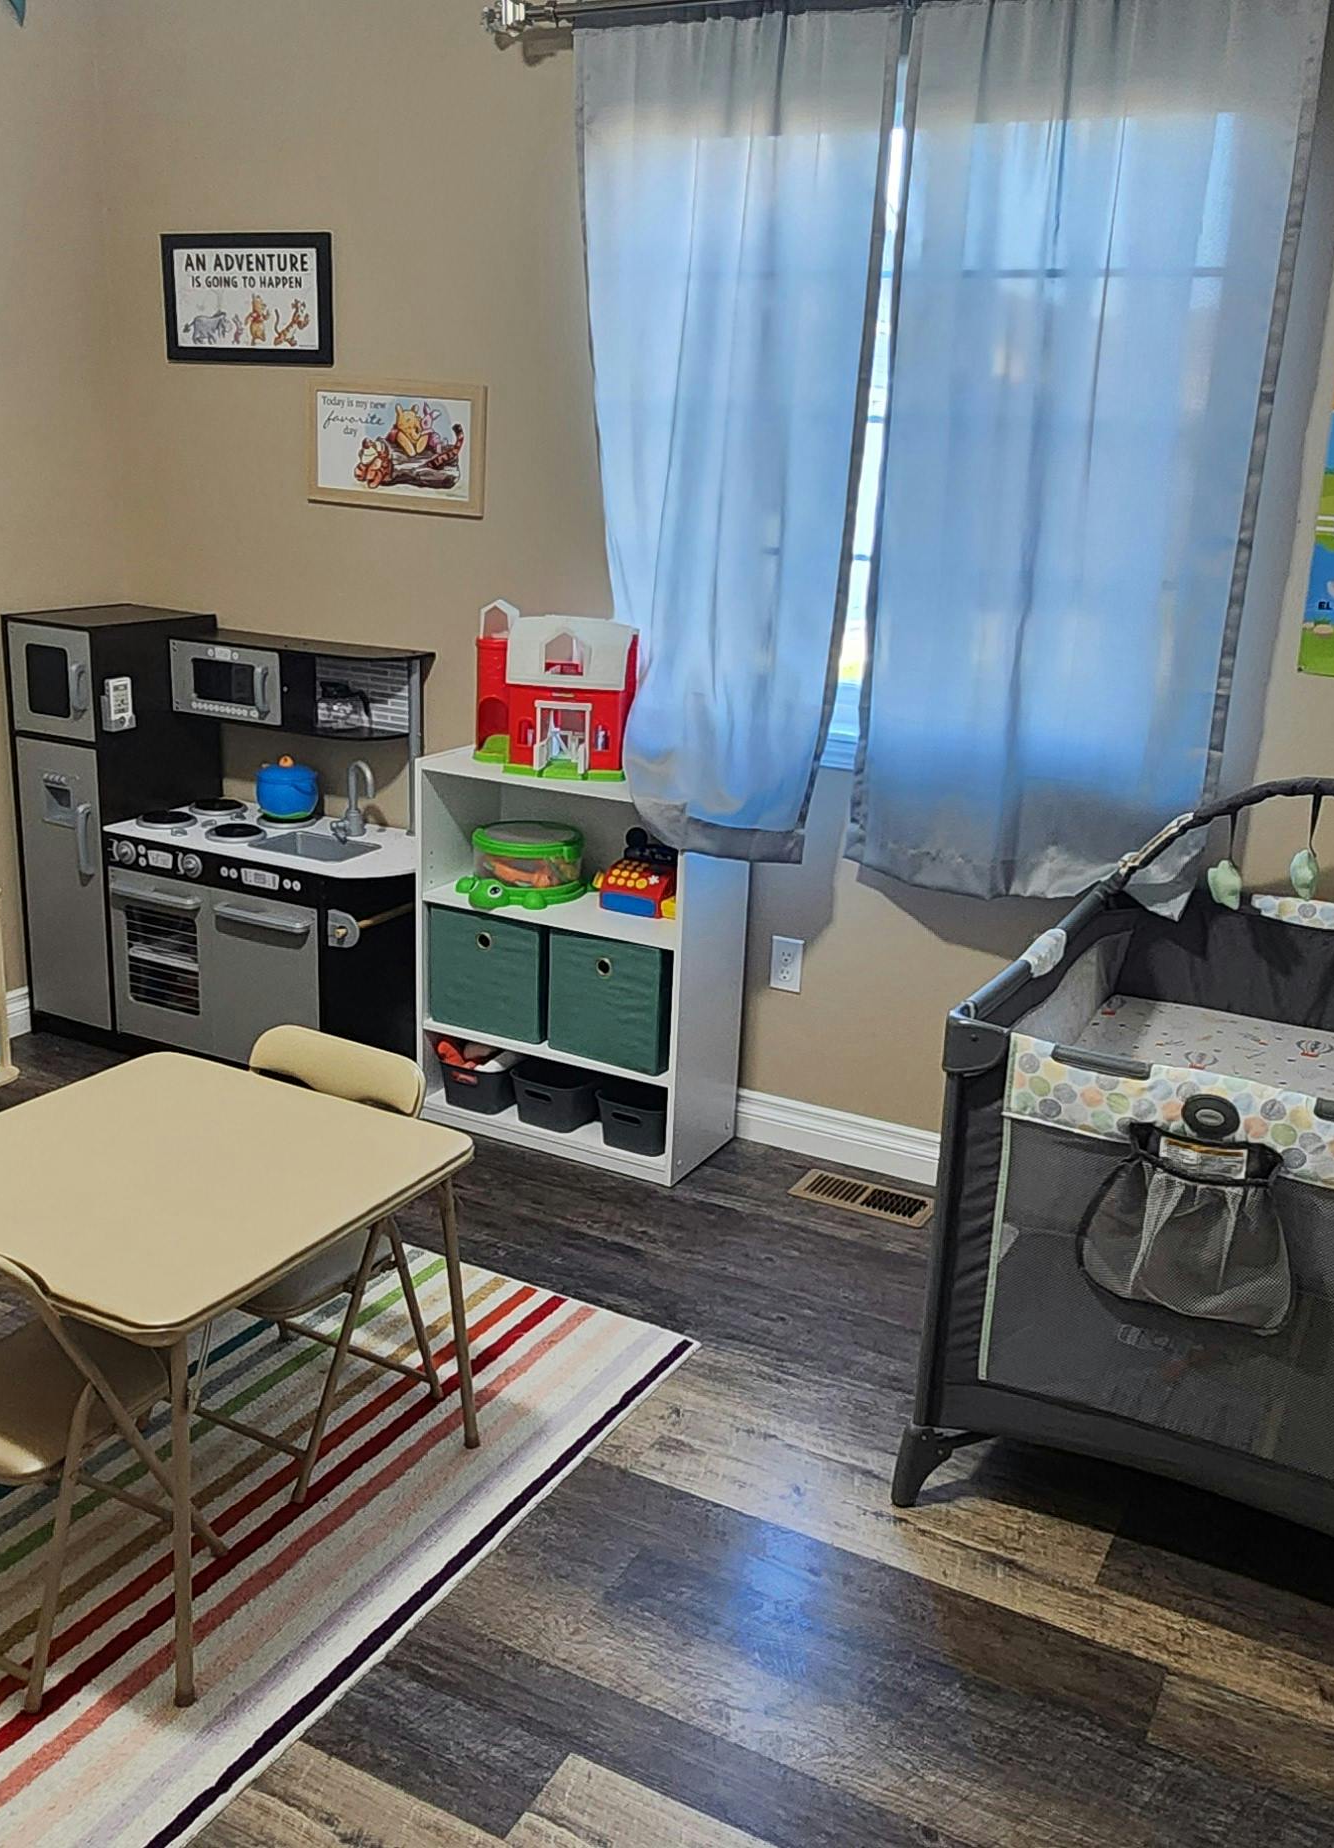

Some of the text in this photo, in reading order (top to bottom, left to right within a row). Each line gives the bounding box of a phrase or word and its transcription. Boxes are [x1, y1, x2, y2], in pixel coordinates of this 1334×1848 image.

[184, 253, 309, 272] AN ADVENTURE
[191, 276, 302, 289] IS GOING TO HAPPEN
[321, 396, 387, 410] Today is my new
[322, 410, 385, 429] favorite
[343, 425, 357, 437] day
[1318, 602, 1334, 611] EL
